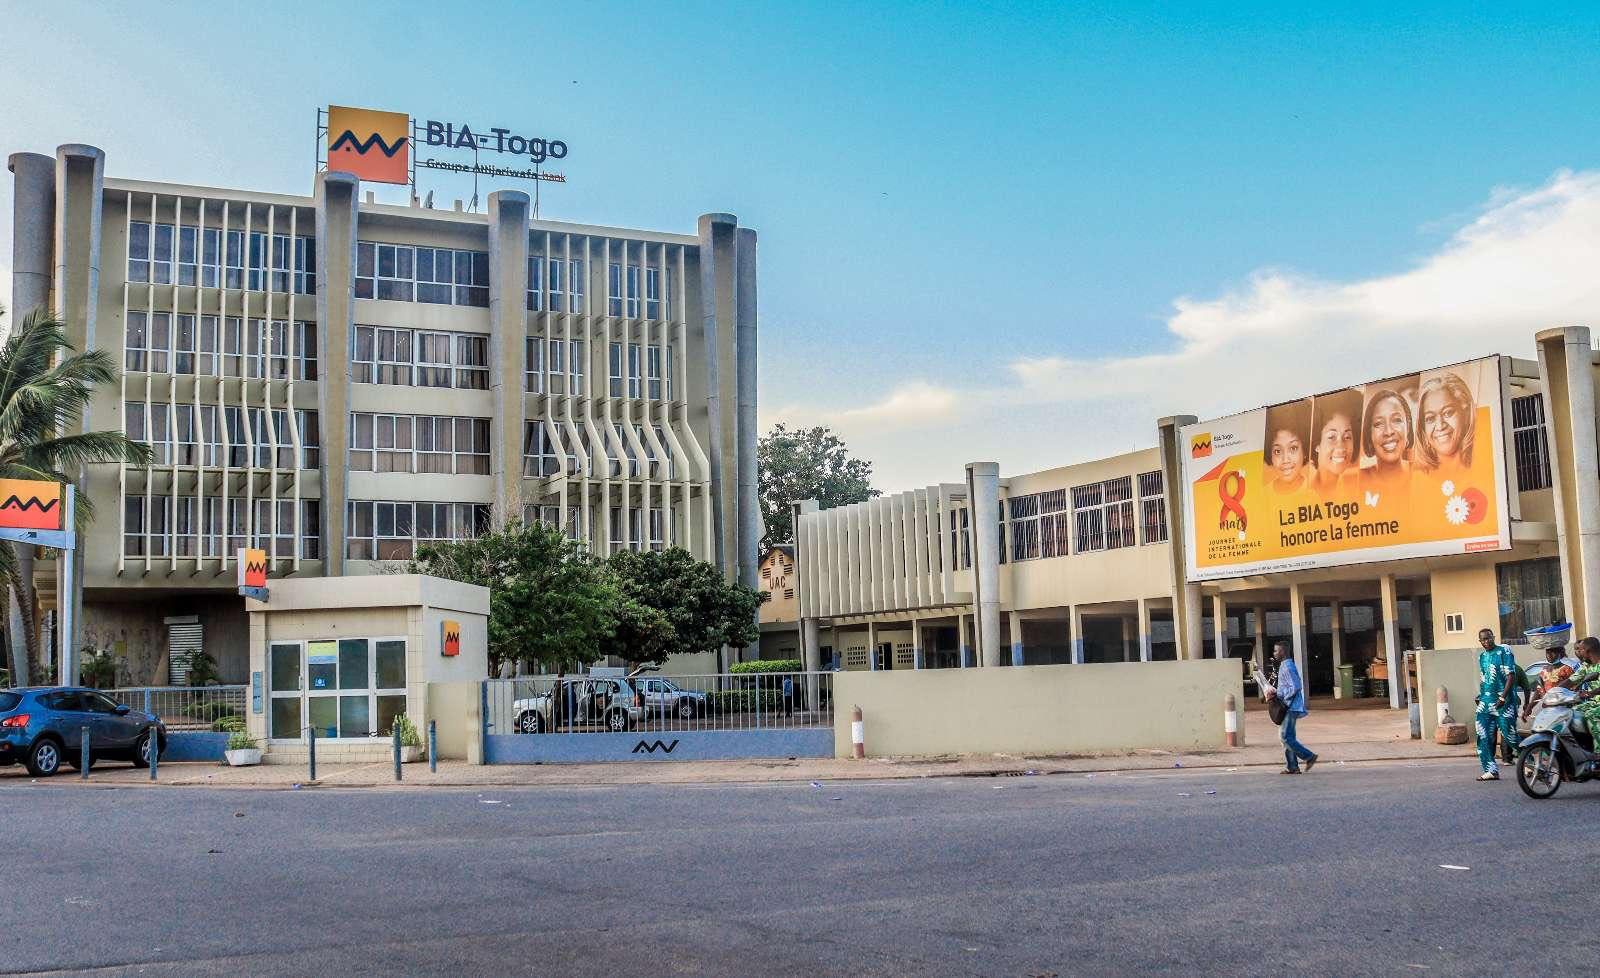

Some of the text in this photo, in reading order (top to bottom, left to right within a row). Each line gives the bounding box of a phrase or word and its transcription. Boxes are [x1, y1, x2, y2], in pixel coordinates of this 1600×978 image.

[427, 120, 568, 163] BIA-Togo
[427, 158, 469, 174] Groupe
[1280, 501, 1359, 526] La BIA Togo
[1280, 520, 1399, 548] honore la femme
[1208, 540, 1262, 553] INTERNATIONALE
[1229, 549, 1249, 558] FEMME
[769, 575, 786, 590] UAC
